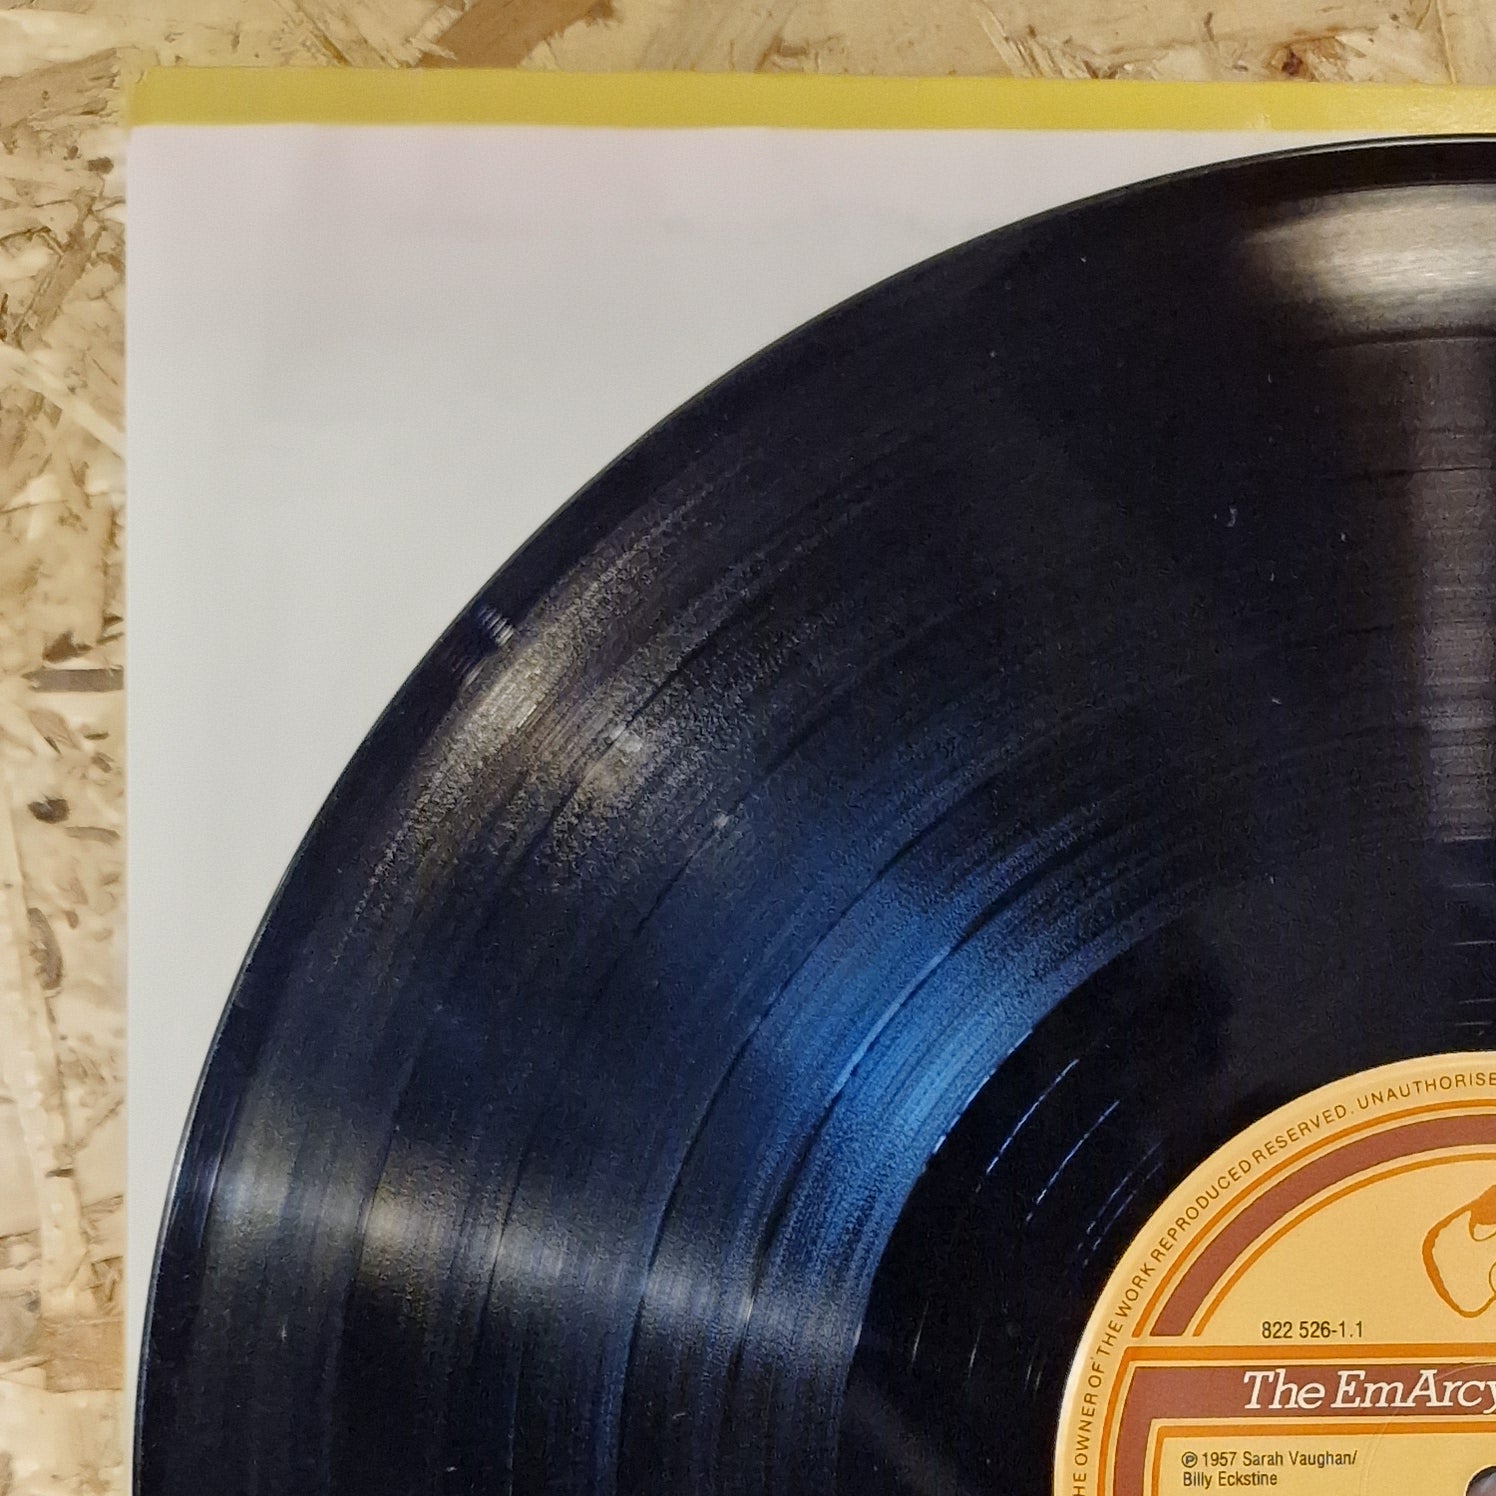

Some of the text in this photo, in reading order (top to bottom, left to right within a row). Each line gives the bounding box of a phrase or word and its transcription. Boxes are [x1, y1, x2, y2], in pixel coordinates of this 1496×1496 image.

[1149, 1158, 1252, 1263] REPRODUCED
[1113, 1261, 1157, 1318] WORK
[1094, 1318, 1124, 1356] THE
[1261, 1320, 1363, 1340] 822 526-1.1
[1086, 1360, 1105, 1389] OF
[1243, 1368, 1326, 1409] The
[1073, 1391, 1099, 1467] OWNER
[1201, 1451, 1238, 1468] 1957
[1242, 1450, 1284, 1467] Sarah
[1288, 1449, 1358, 1469] Vaughan/
[1183, 1470, 1278, 1491] Billy Eckstine
